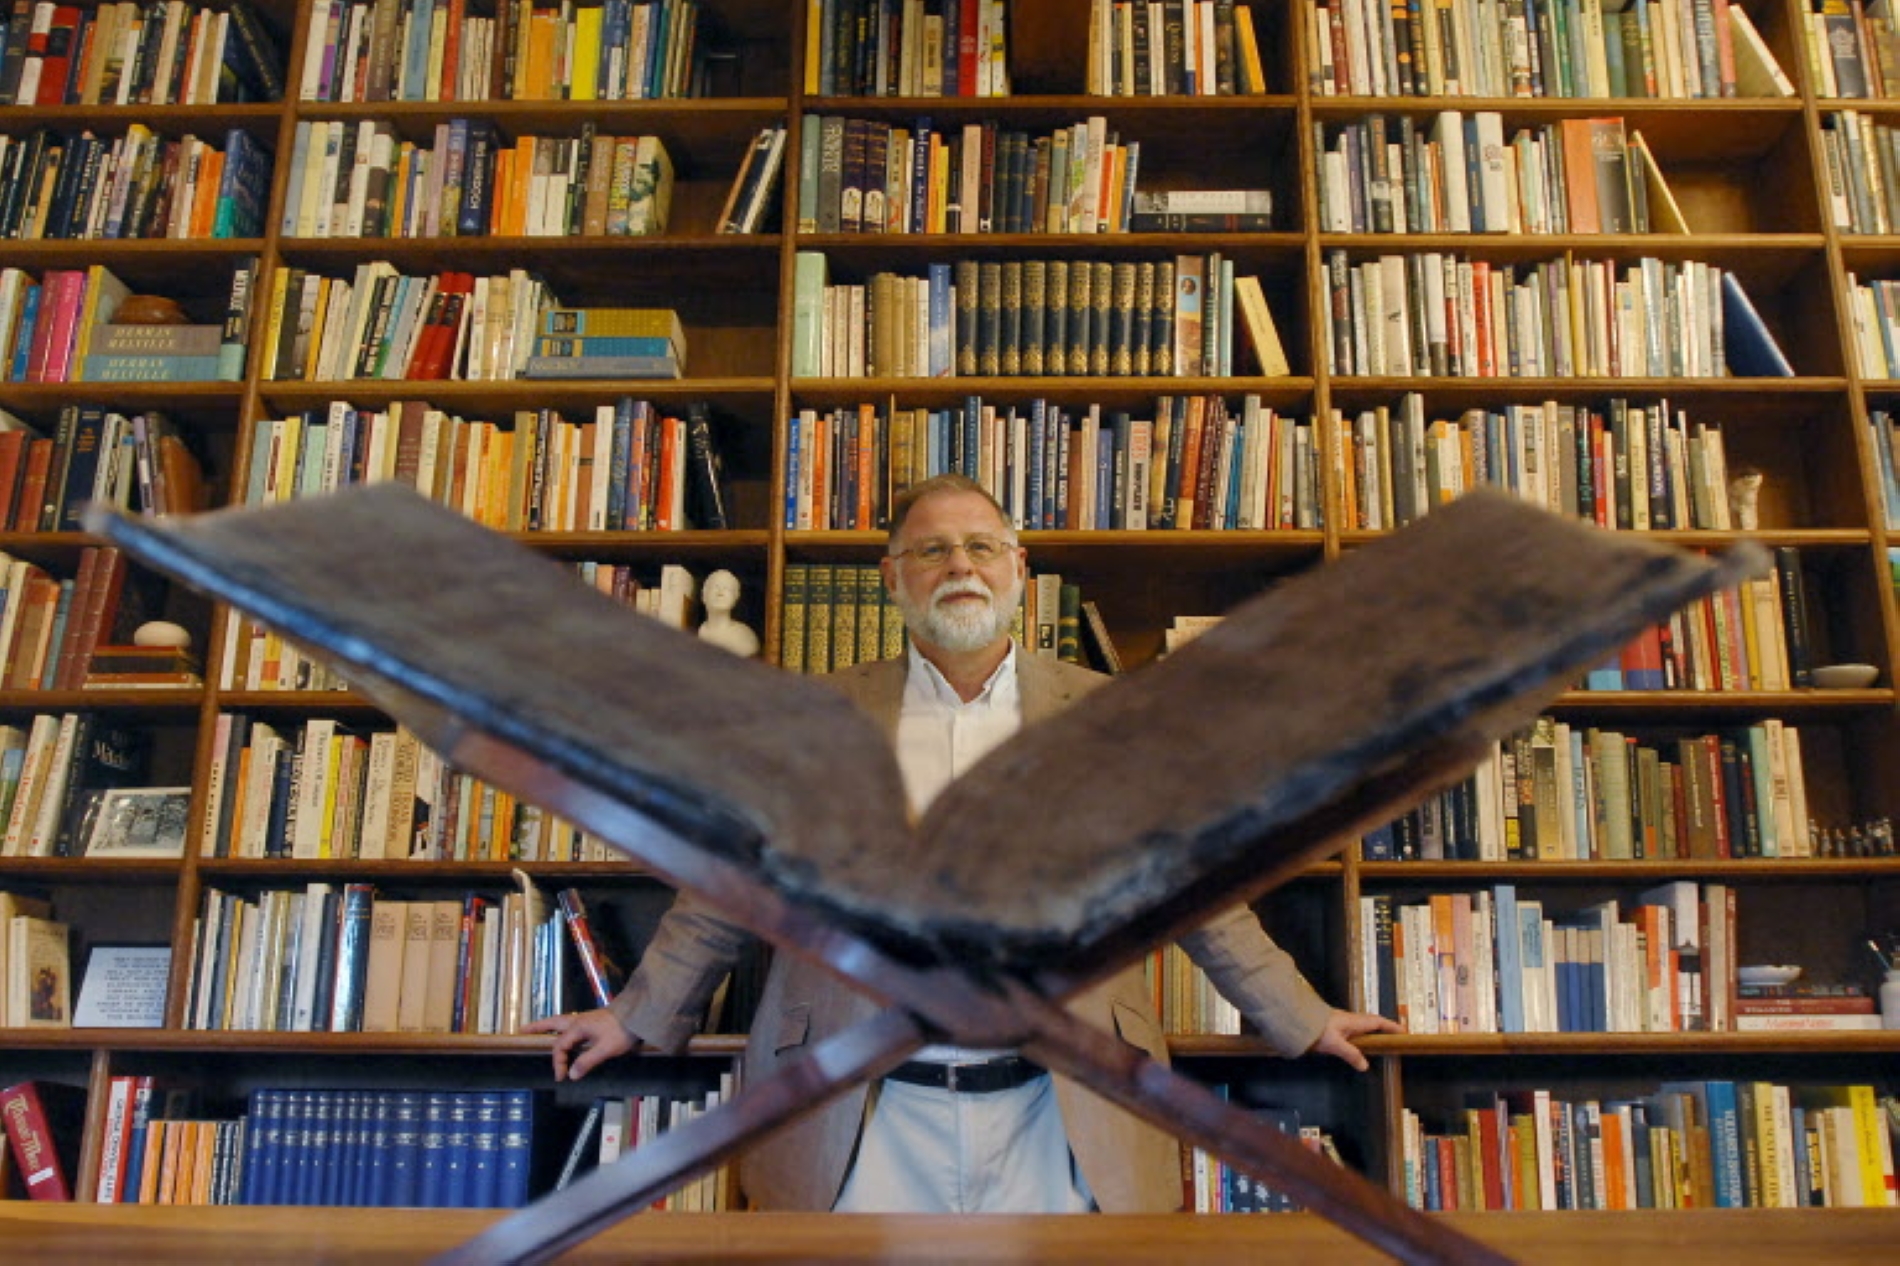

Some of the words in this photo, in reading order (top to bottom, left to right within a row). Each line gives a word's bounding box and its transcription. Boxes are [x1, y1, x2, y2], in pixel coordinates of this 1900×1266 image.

[114, 327, 173, 338] HERMAN
[107, 338, 177, 349] MELVILLE
[107, 358, 165, 368] HERMAN
[101, 368, 171, 380] MELVILLE
